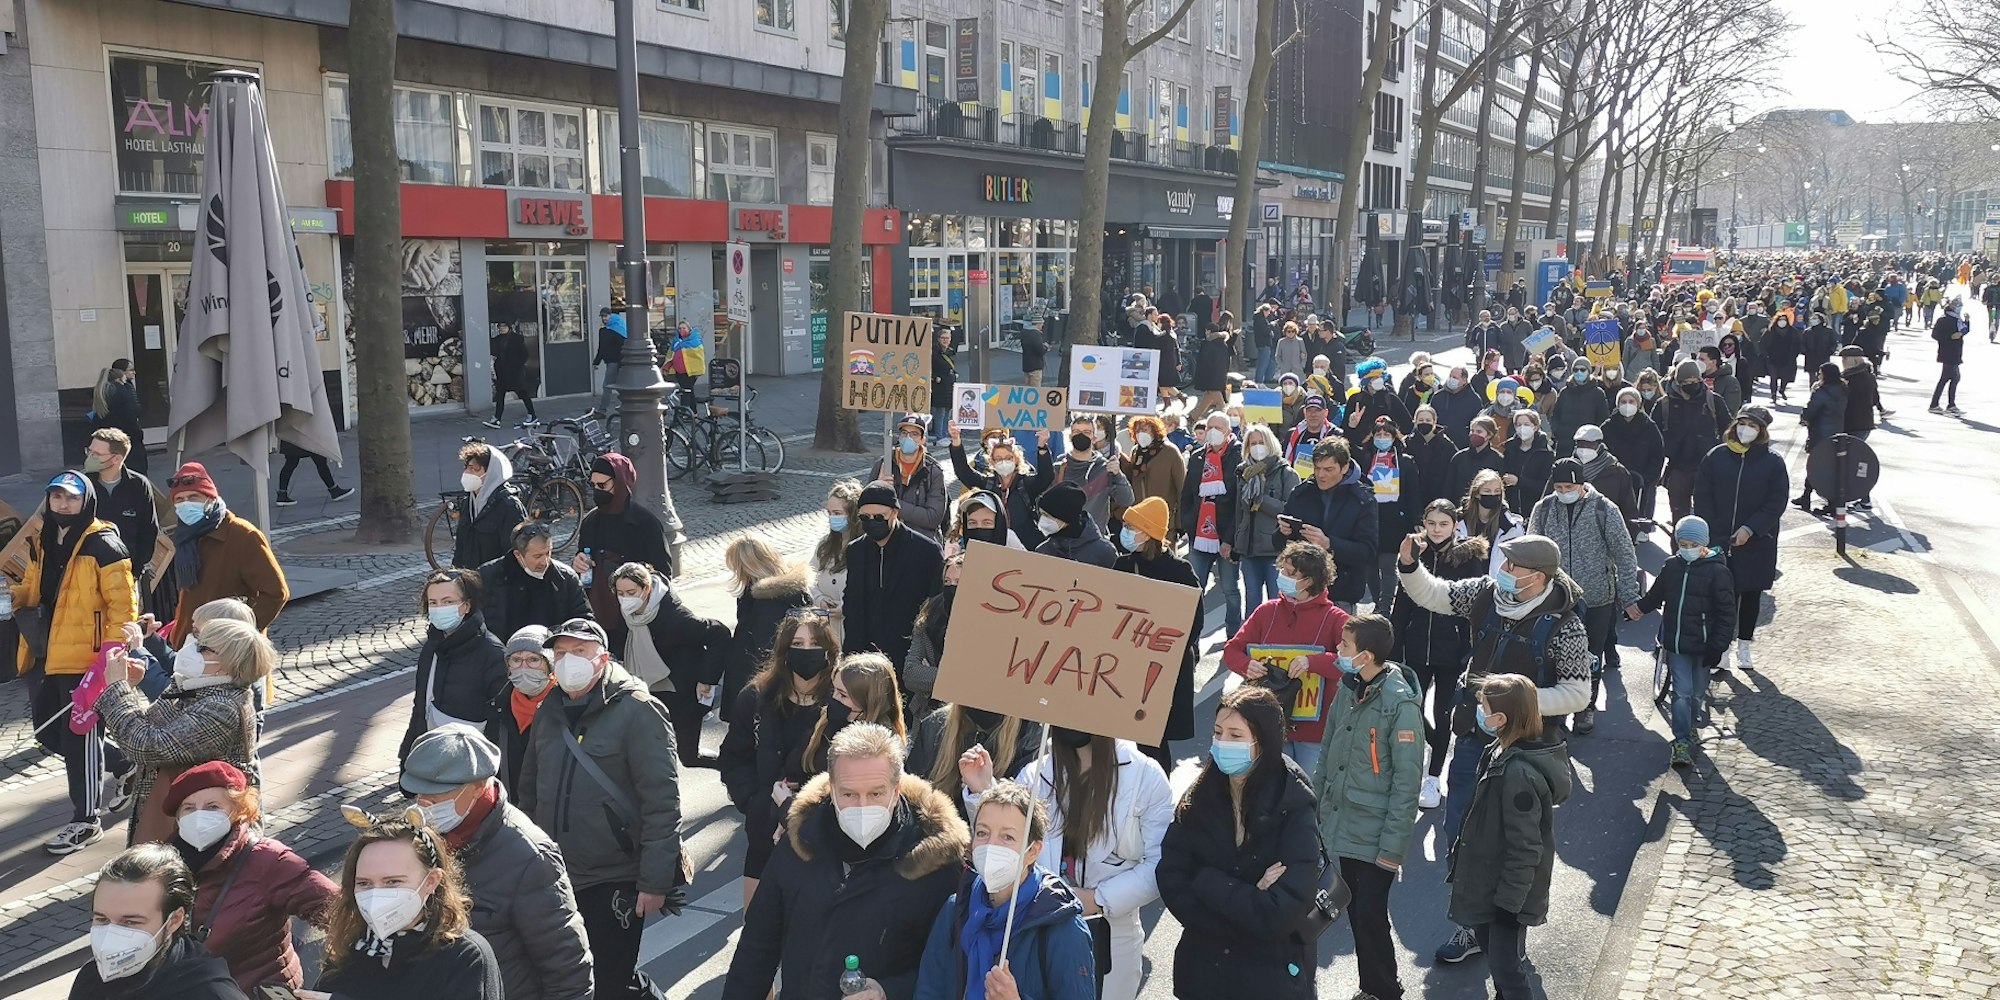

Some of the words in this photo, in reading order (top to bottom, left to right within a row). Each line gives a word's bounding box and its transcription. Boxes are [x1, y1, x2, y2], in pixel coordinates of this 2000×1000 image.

[960, 20, 974, 75] BUTLERS
[125, 138, 158, 152] HOTEL
[986, 175, 1036, 203] BUTLERS
[133, 212, 164, 225] HOTEL
[519, 198, 585, 226] REWE
[738, 208, 784, 231] REWE
[168, 242, 181, 253] 20
[850, 315, 928, 347] PUTIN
[1591, 322, 1607, 330] NO
[881, 351, 920, 378] GO
[849, 380, 927, 413] HOMO
[1007, 387, 1040, 406] NO
[957, 417, 979, 425] PUTIN
[997, 408, 1049, 428] WAR
[980, 569, 1103, 629] STOP
[1111, 603, 1186, 654] THE
[1006, 636, 1125, 700] WAR
